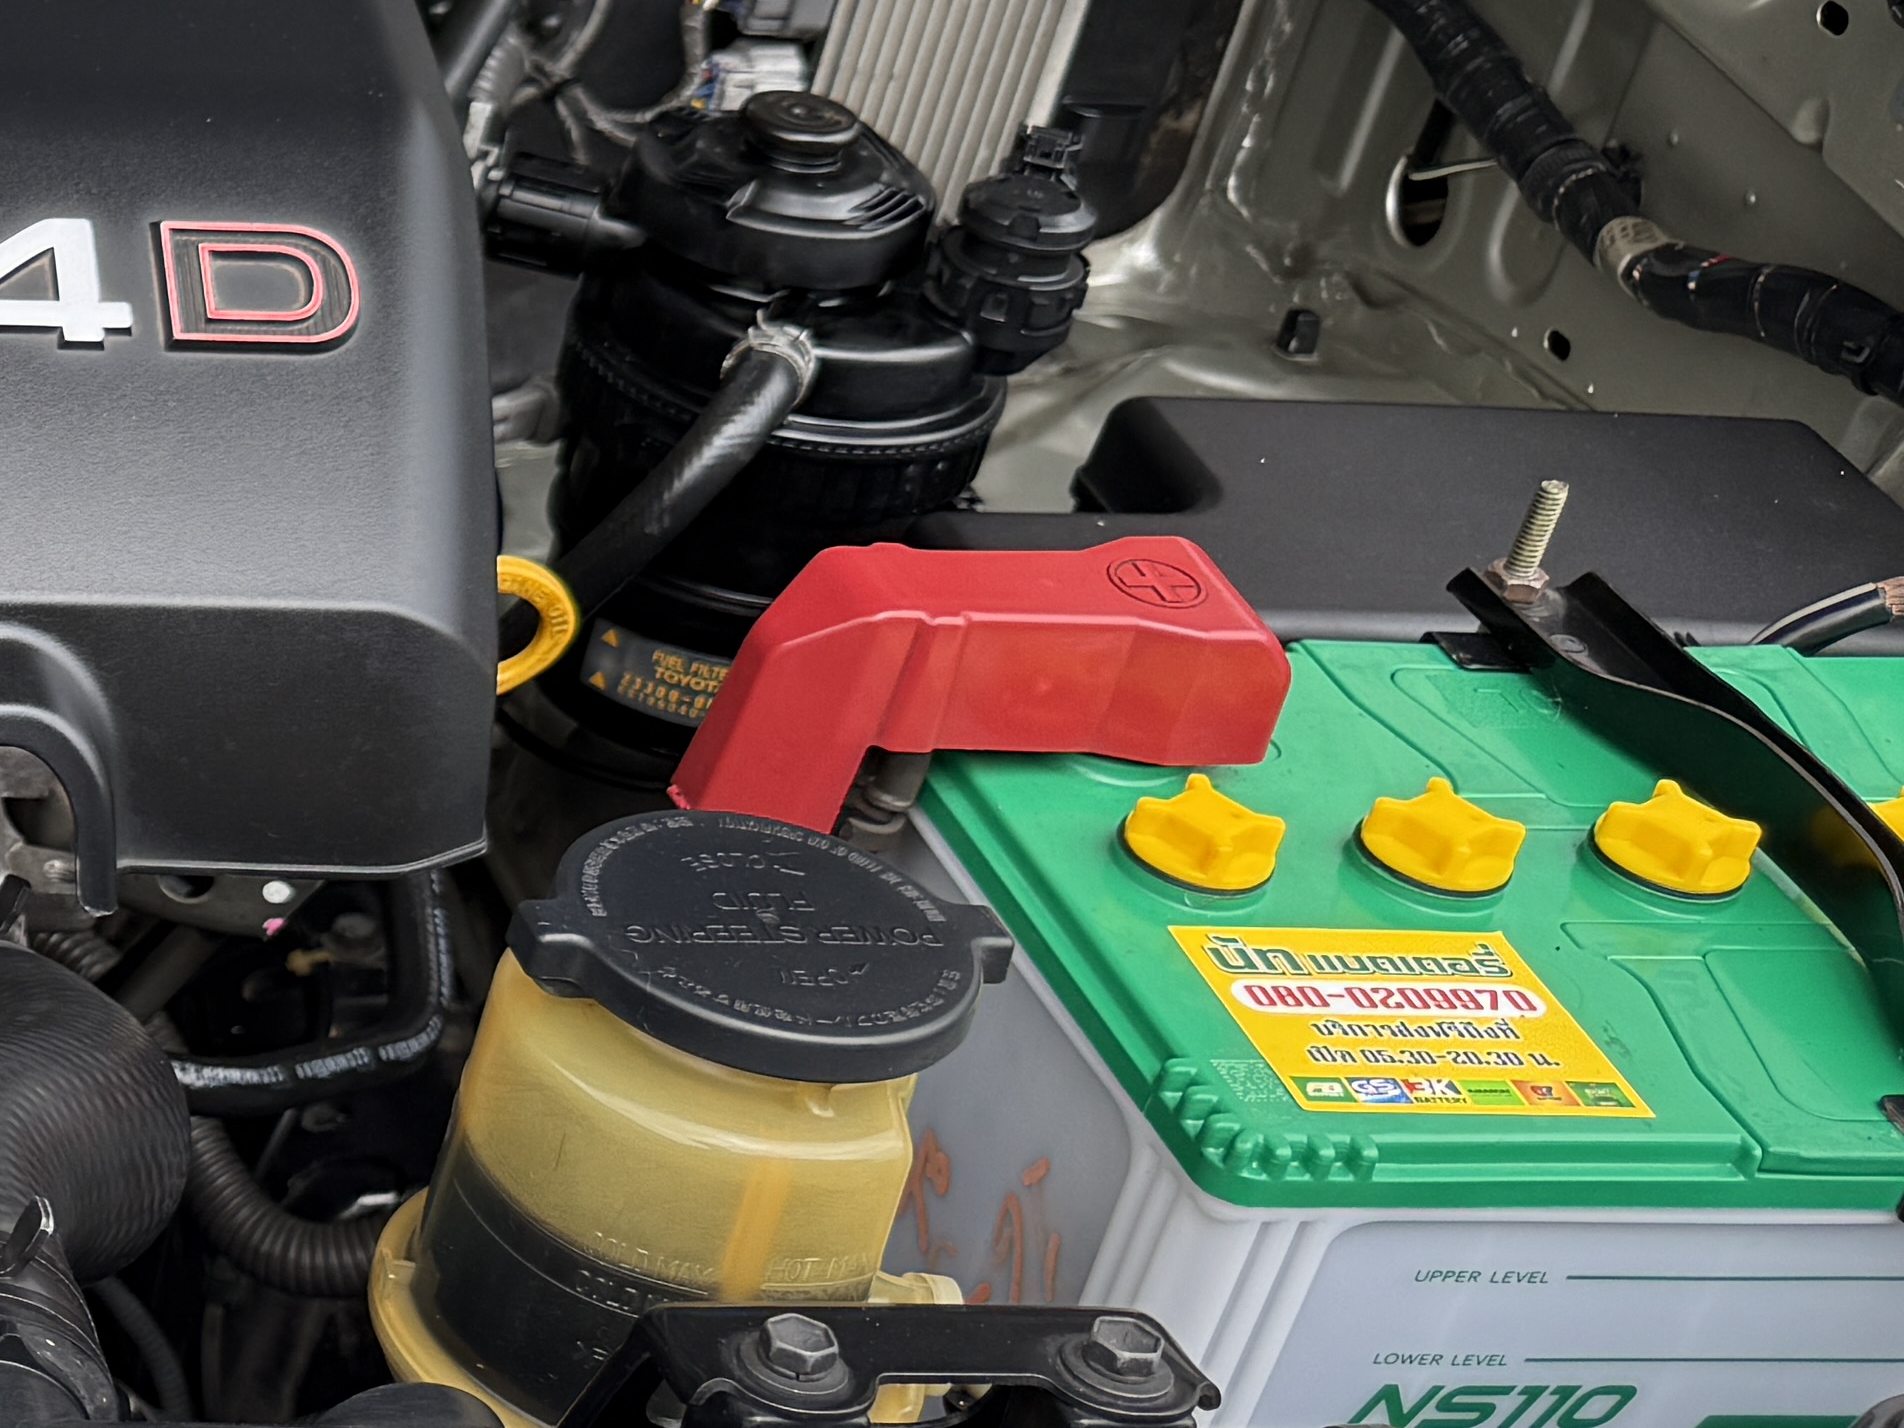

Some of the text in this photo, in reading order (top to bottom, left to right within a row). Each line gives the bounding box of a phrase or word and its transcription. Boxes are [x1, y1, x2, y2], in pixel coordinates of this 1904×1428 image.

[652, 649, 732, 681] FUEL FILTE
[654, 666, 724, 694] TOYOT
[710, 891, 817, 913] FLUID
[622, 923, 944, 947] POWER STEERING
[1242, 984, 1539, 1012] 080-0209970
[1360, 1048, 1524, 1067] 05.30-20.30
[1413, 1096, 1468, 1104] BATTERY
[1414, 1269, 1549, 1284] UPPER LEVEL
[1372, 1353, 1508, 1366] LOWER LEVEL
